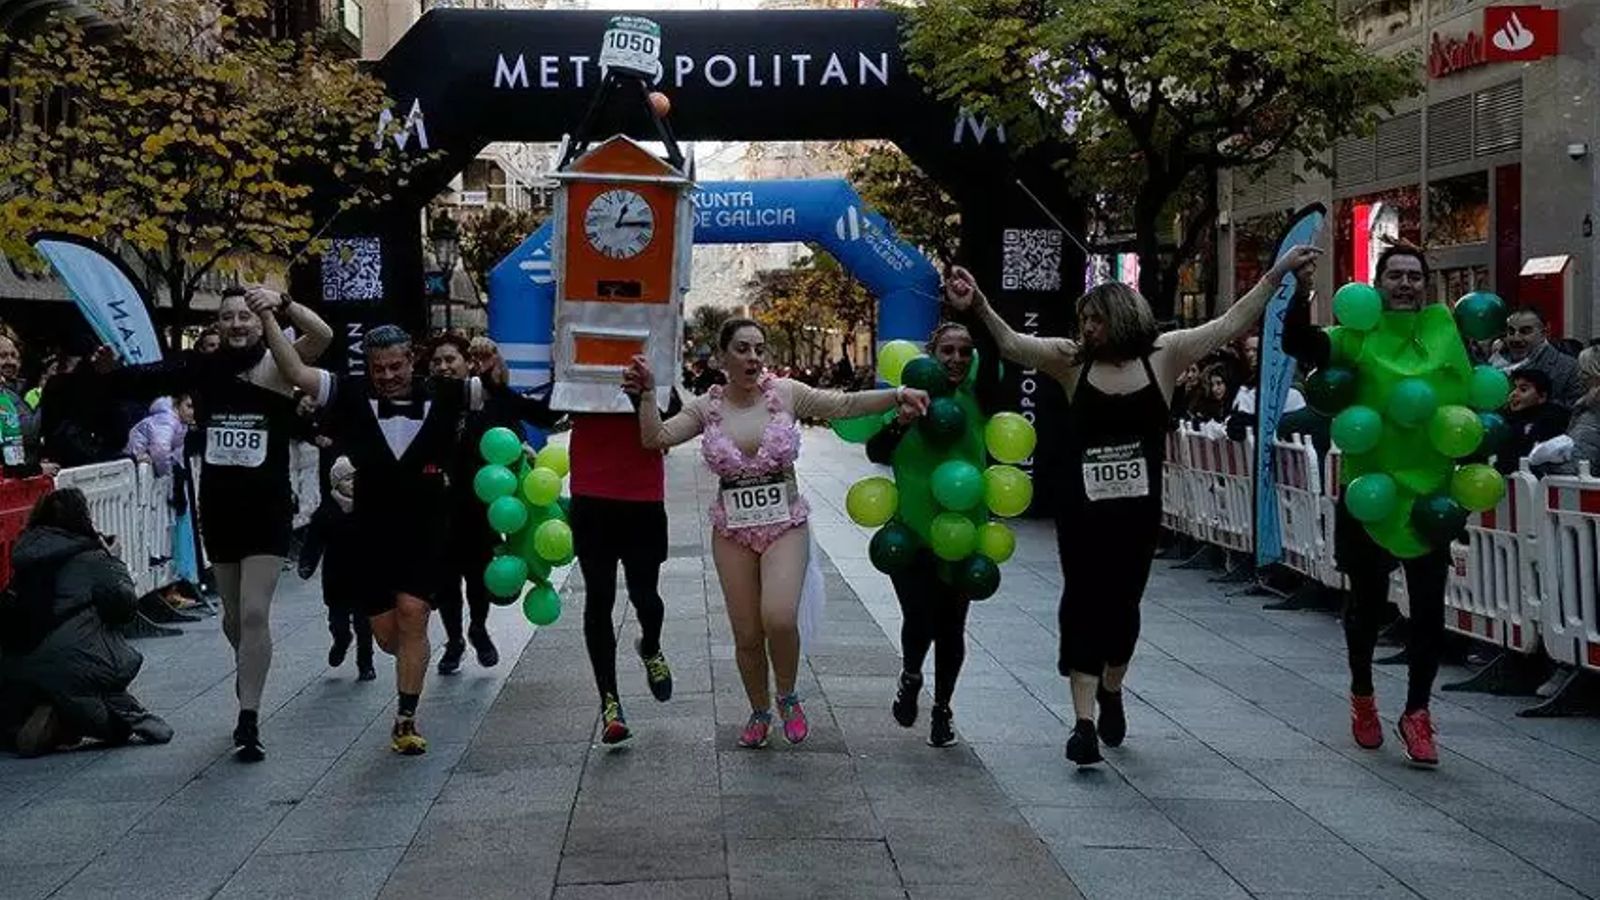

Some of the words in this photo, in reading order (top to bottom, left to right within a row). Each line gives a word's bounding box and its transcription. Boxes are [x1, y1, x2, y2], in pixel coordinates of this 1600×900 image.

[609, 32, 654, 54] 1050
[493, 52, 890, 88] METPOLITAN
[715, 208, 796, 226] GALICIA
[214, 430, 261, 449] 1038
[1091, 462, 1141, 482] 1063
[732, 487, 781, 509] 1069
